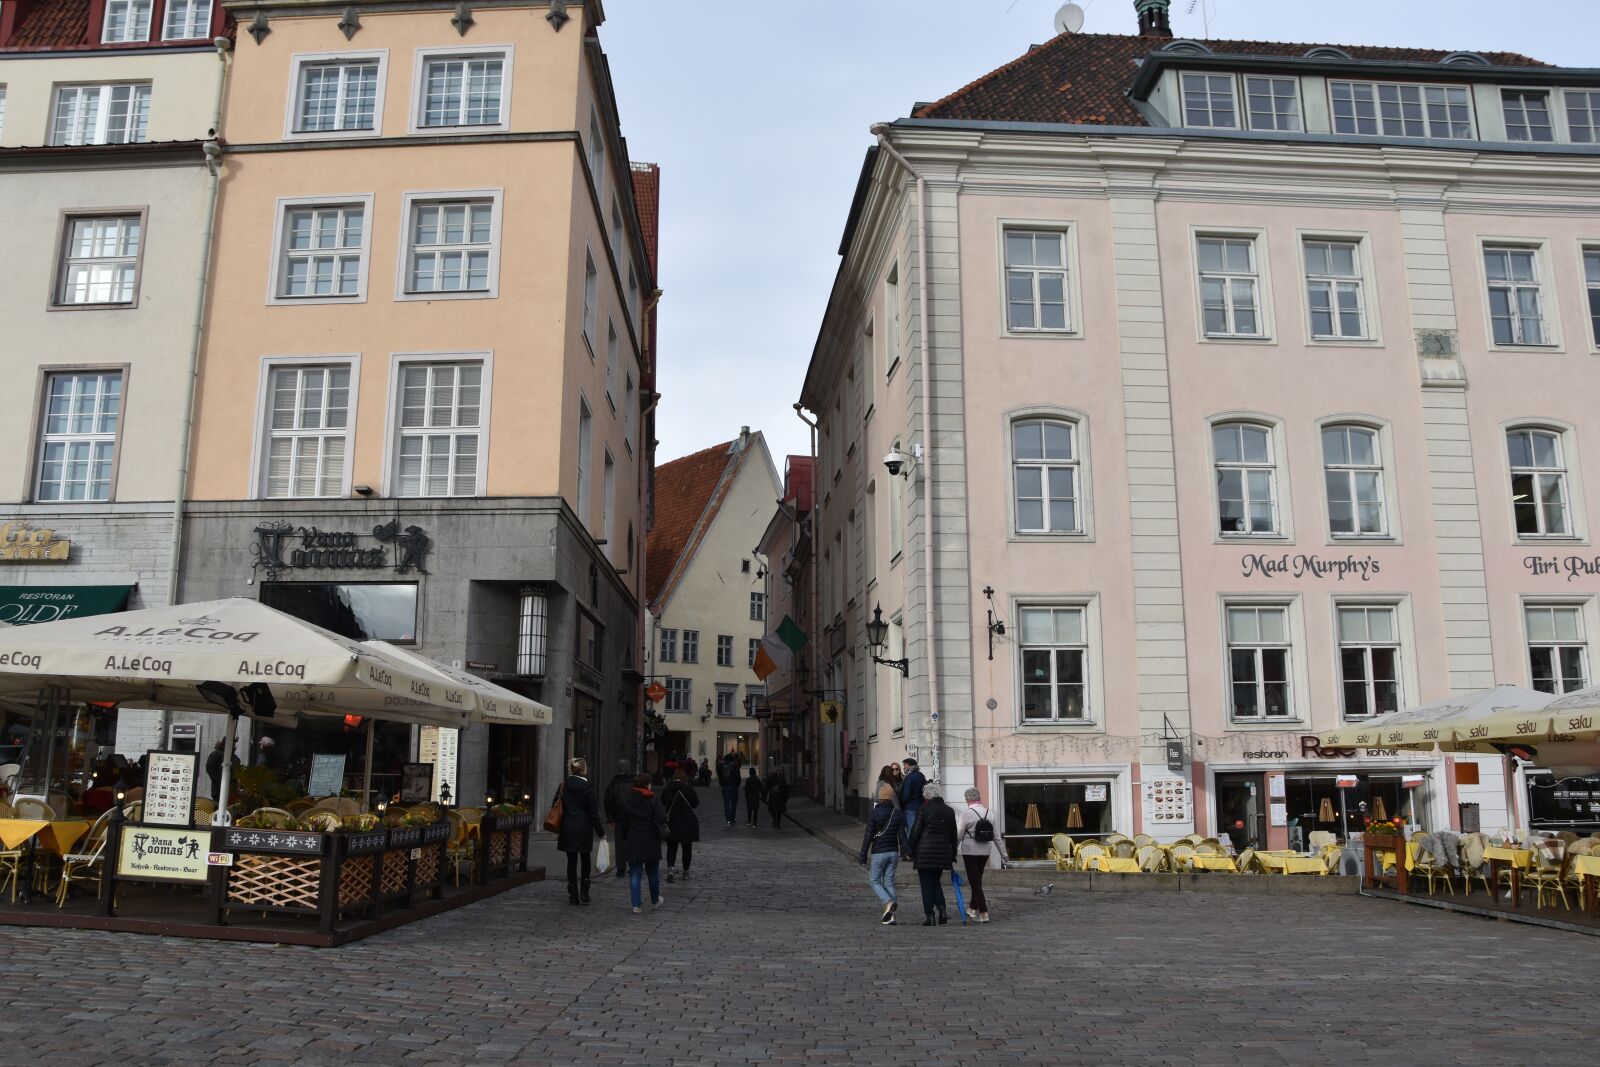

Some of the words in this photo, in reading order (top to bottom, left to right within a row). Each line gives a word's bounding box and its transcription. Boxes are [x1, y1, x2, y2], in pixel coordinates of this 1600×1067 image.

[1241, 554, 1289, 578] Mad
[1293, 554, 1380, 581] Murphy's
[1523, 556, 1560, 575] Tiri
[1516, 720, 1537, 734] saku
[1569, 715, 1592, 730] saku
[1423, 727, 1439, 740] saku
[1469, 724, 1489, 738] saku
[1243, 749, 1289, 759] restoran
[151, 836, 172, 847] Vana
[153, 864, 179, 872] Restoran
